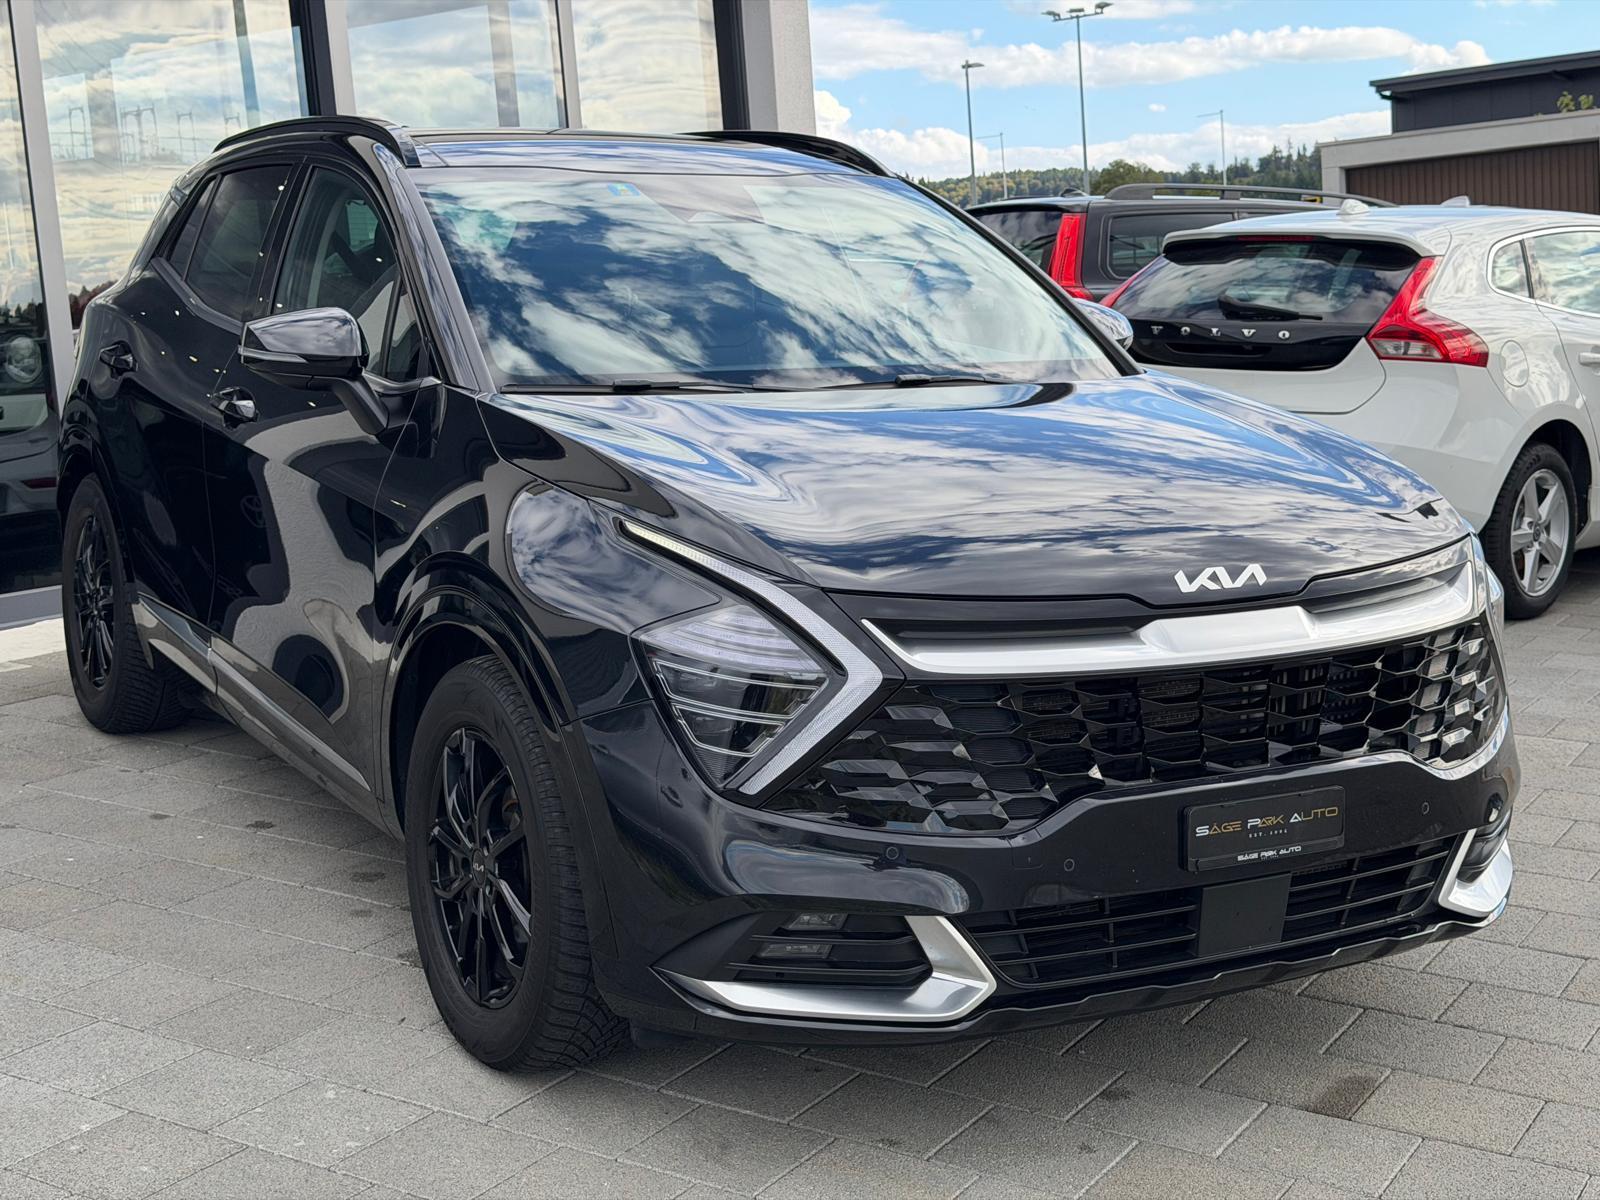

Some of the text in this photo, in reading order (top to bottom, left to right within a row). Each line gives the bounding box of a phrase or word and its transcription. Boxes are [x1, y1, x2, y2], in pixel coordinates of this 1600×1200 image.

[1151, 326, 1290, 339] VOLVO
[1174, 563, 1267, 593] KIA
[1247, 815, 1284, 829] PARK
[1289, 807, 1338, 822] AUTO
[1279, 846, 1301, 854] AUTO
